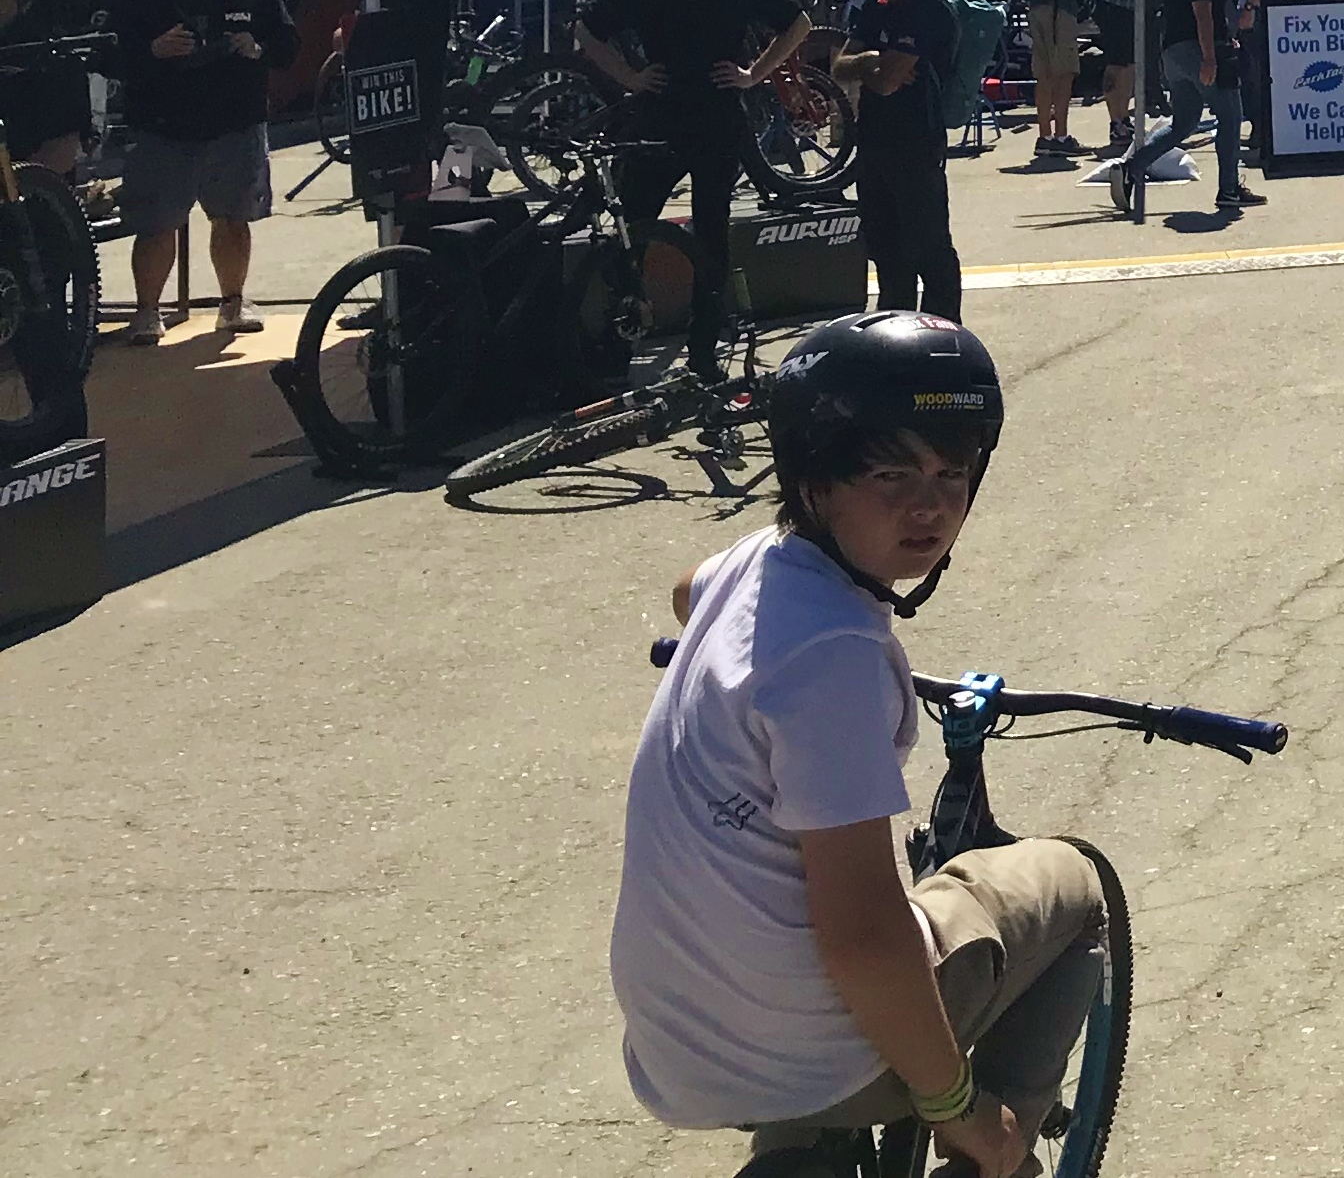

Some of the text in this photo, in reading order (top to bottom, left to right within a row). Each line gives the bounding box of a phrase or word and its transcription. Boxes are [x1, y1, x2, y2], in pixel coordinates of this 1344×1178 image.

[1284, 15, 1311, 34] Fix
[1277, 36, 1320, 54] Own
[361, 69, 405, 89] WIN THIS
[356, 85, 412, 121] BIKE!
[1288, 103, 1321, 121] We
[756, 215, 862, 246] AURUM
[827, 233, 858, 246] HSP
[913, 392, 984, 405] WOODWARD
[0, 452, 101, 507] ANGE
